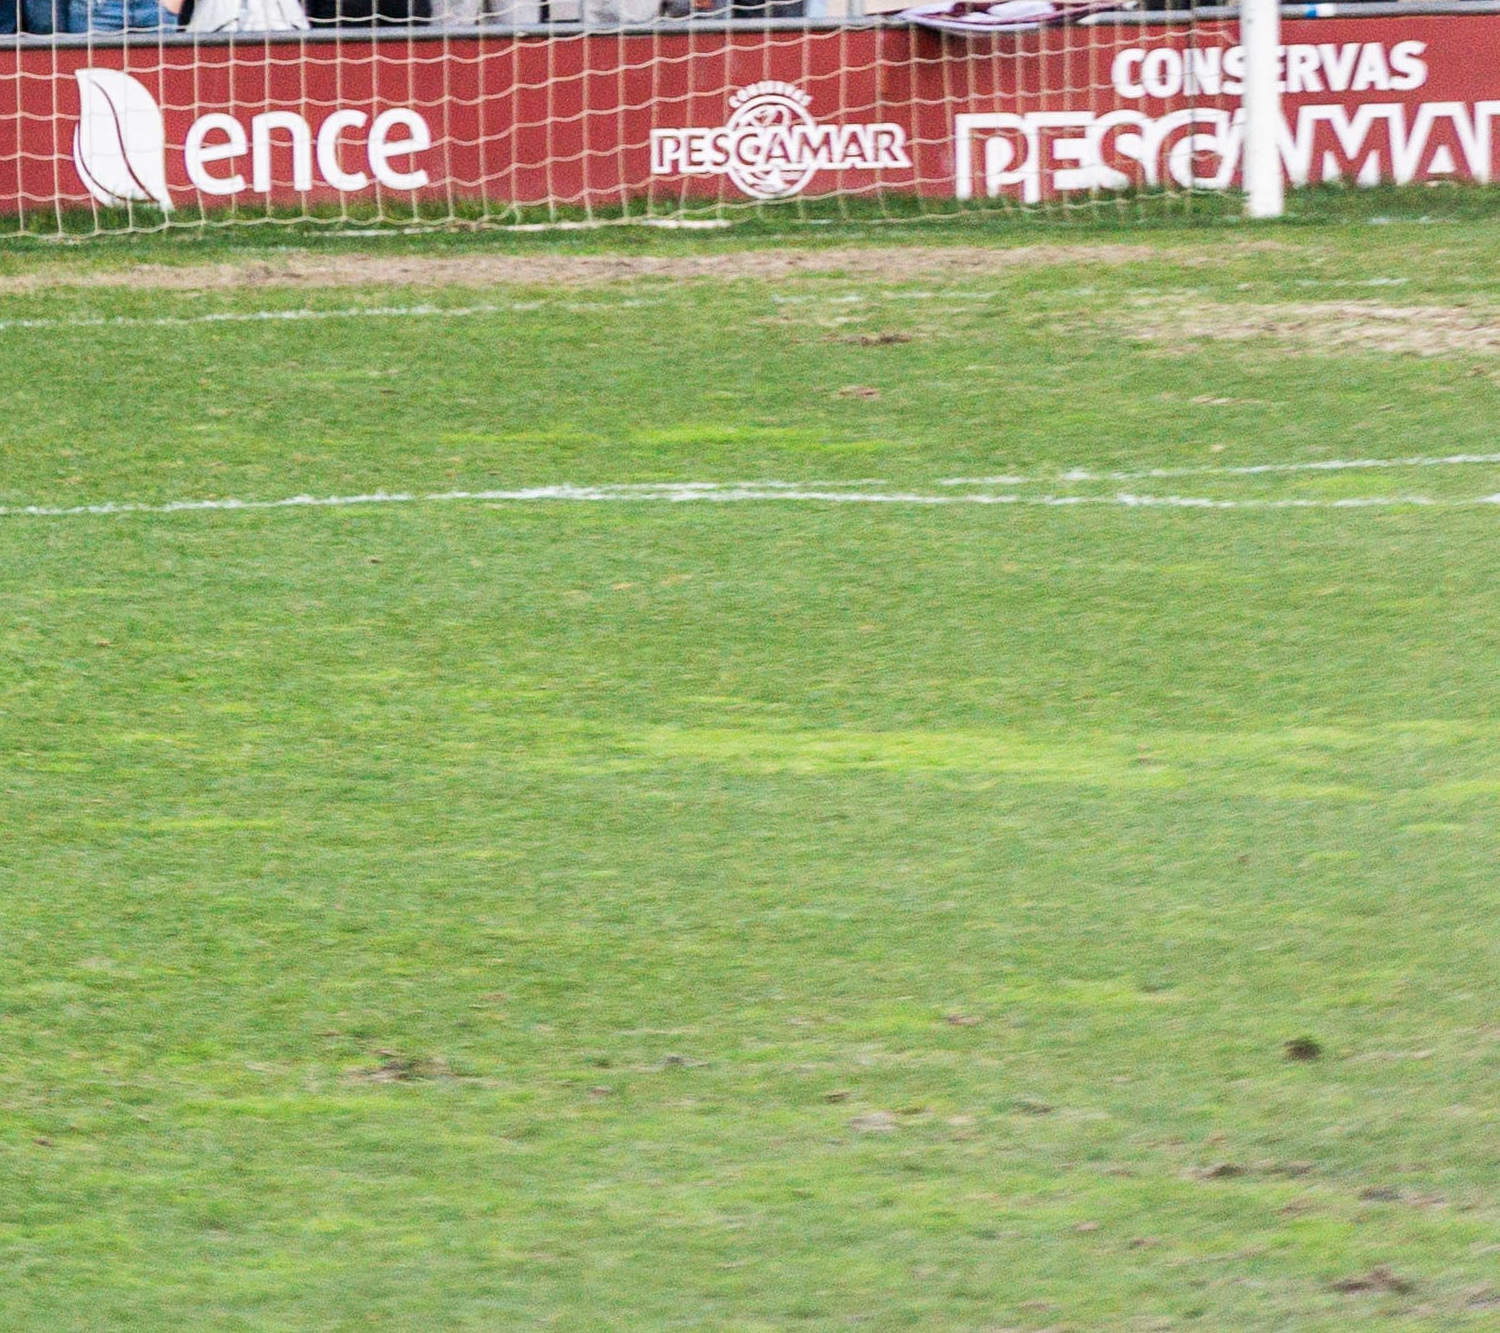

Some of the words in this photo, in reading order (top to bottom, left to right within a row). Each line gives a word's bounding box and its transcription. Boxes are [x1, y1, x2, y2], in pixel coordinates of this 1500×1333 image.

[185, 107, 432, 195] ence
[651, 123, 913, 175] PESCAMAR
[955, 100, 1500, 204] PESCAMA
